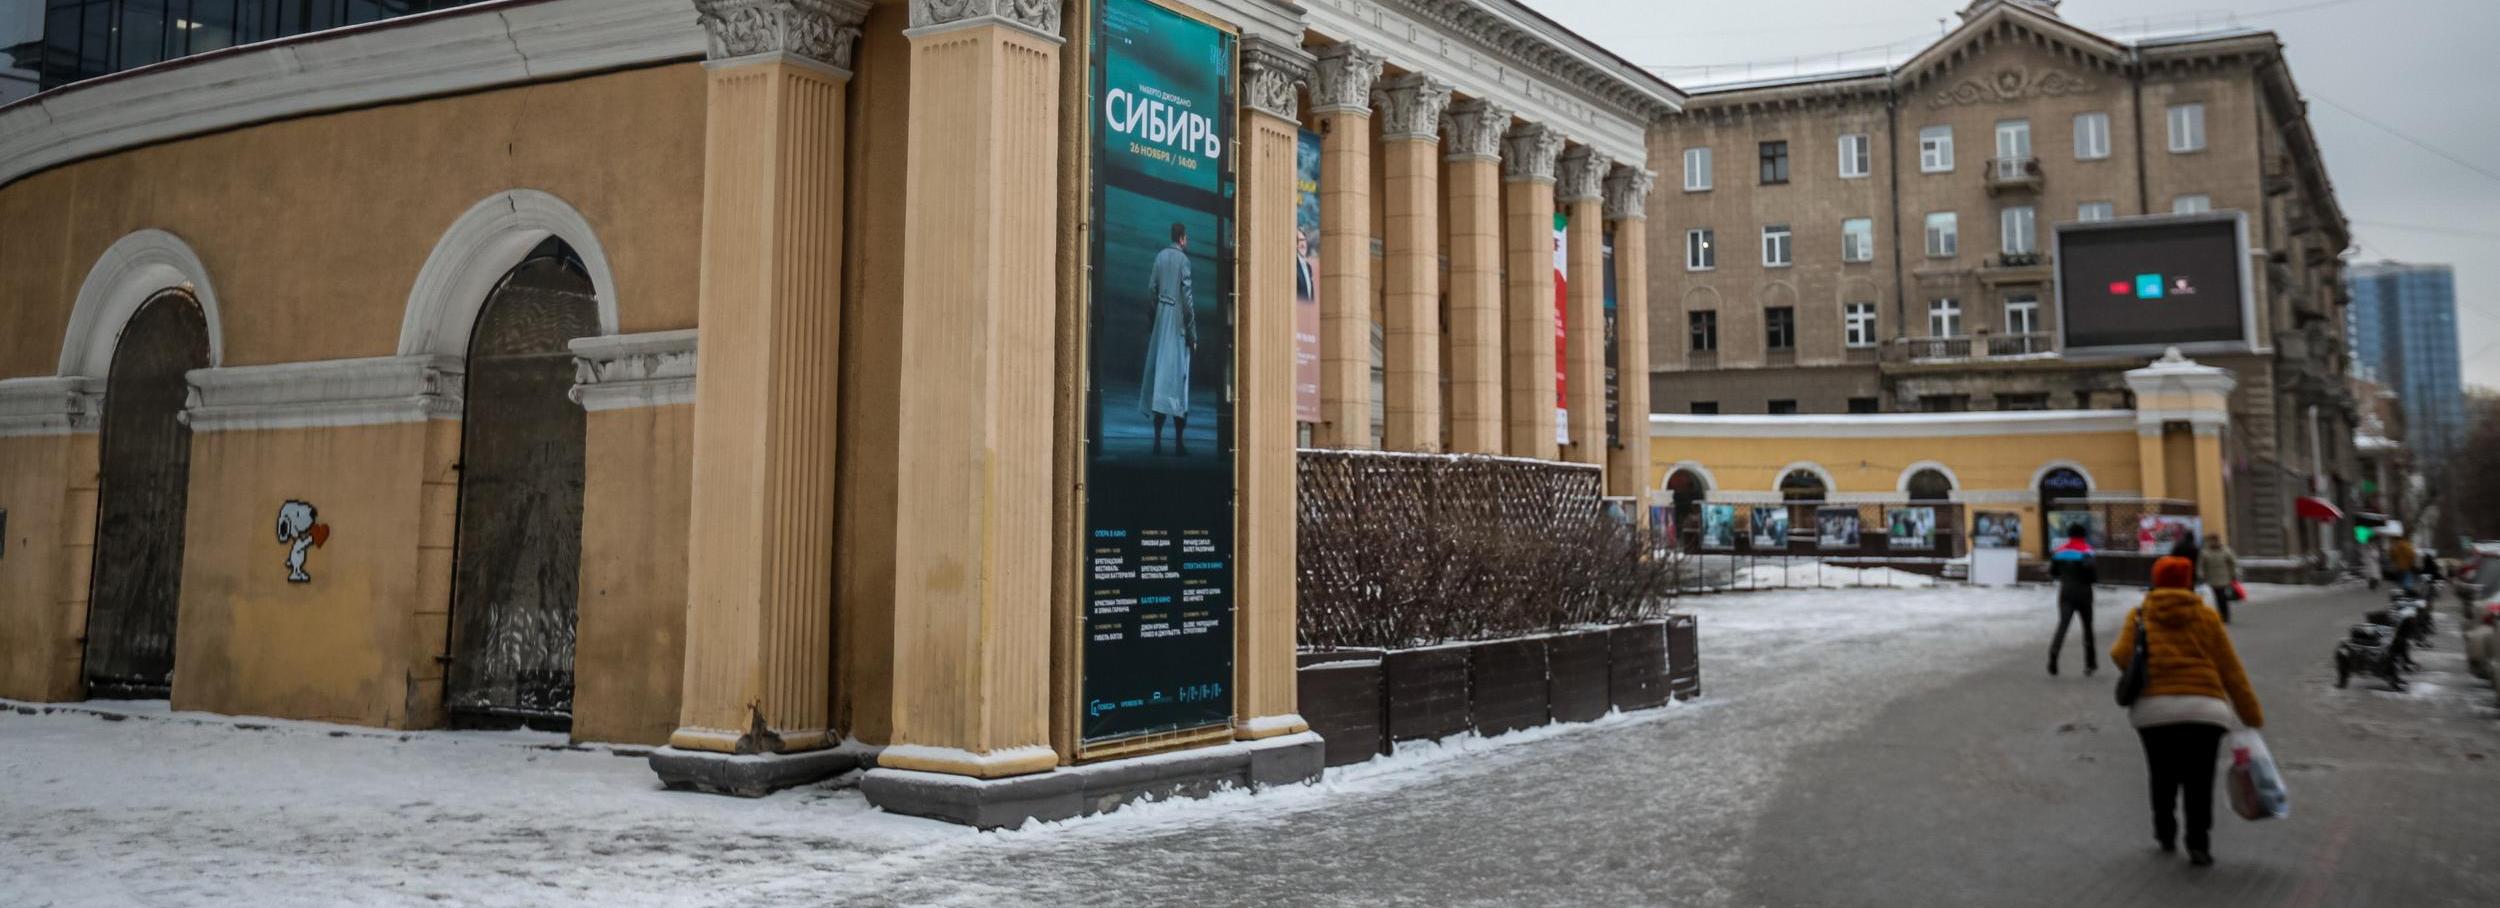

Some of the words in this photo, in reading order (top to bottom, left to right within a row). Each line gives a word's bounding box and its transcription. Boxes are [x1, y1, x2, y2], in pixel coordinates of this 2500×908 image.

[1162, 92, 1192, 108] ДЖОРДАНО
[1106, 88, 1221, 158] СИБИРЬ
[1130, 142, 1140, 154] 26
[1140, 146, 1170, 162] НОЯБРЯ
[1178, 156, 1196, 170] 14:00
